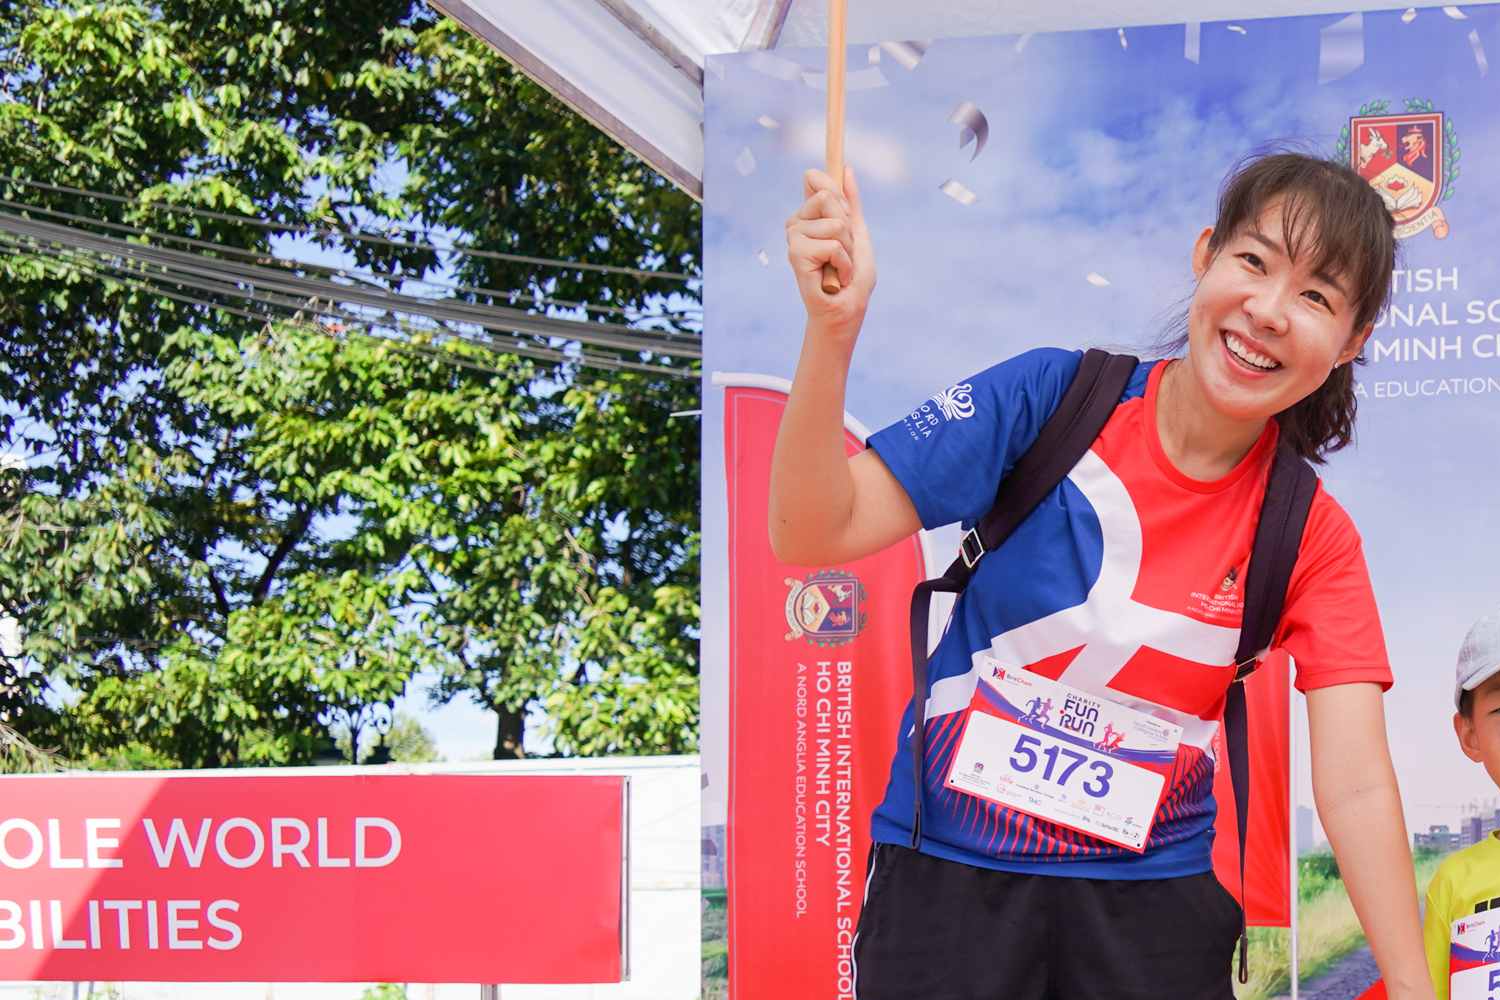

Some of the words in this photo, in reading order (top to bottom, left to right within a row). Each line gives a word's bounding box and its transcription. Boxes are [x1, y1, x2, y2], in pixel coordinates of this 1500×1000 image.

[1373, 335, 1461, 362] MINH
[796, 663, 807, 673] A
[815, 661, 831, 693] HO
[796, 676, 808, 716] NORD
[815, 698, 831, 732] CHI
[837, 662, 852, 739] BRITISH
[1064, 699, 1099, 722] FUN
[796, 720, 808, 772] ANGLIA
[1059, 714, 1095, 737] RUN
[815, 739, 831, 795] MINH
[1009, 733, 1114, 798] 5173
[796, 776, 808, 856] EDUCATION
[815, 800, 831, 846] CITY
[837, 744, 852, 912] INTERNATIONAL
[0, 817, 124, 869] OLE
[143, 816, 402, 869] WORLD
[795, 860, 808, 917] SCHOOL
